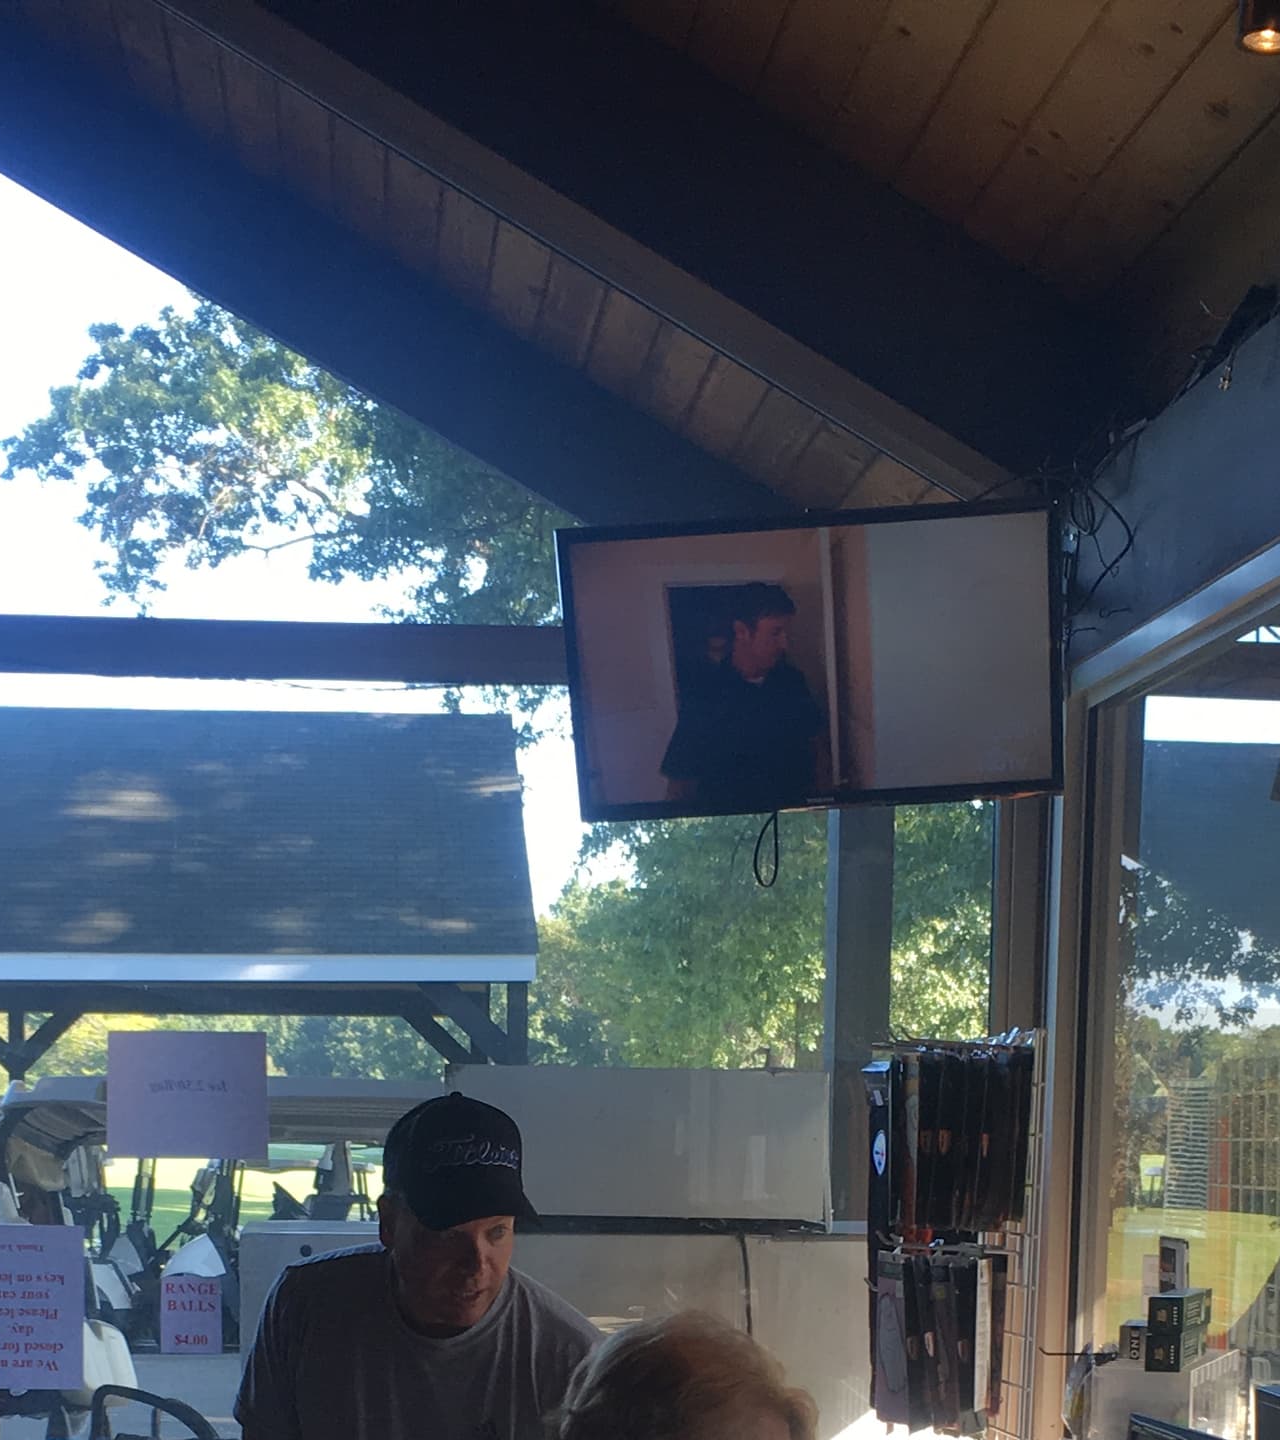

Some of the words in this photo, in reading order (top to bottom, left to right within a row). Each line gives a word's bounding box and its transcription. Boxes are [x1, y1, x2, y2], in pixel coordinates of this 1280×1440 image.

[16, 1274, 33, 1282] on
[35, 1272, 65, 1286] keys
[20, 1289, 51, 1300] your
[165, 1282, 219, 1295] RANGE
[167, 1299, 217, 1312] BALLS
[19, 1308, 59, 1321] Please
[7, 1322, 35, 1336] day.
[174, 1334, 208, 1345] $4.00
[0, 1342, 20, 1353] for
[24, 1342, 64, 1354] closed
[12, 1360, 34, 1369] are
[36, 1359, 59, 1371] We
